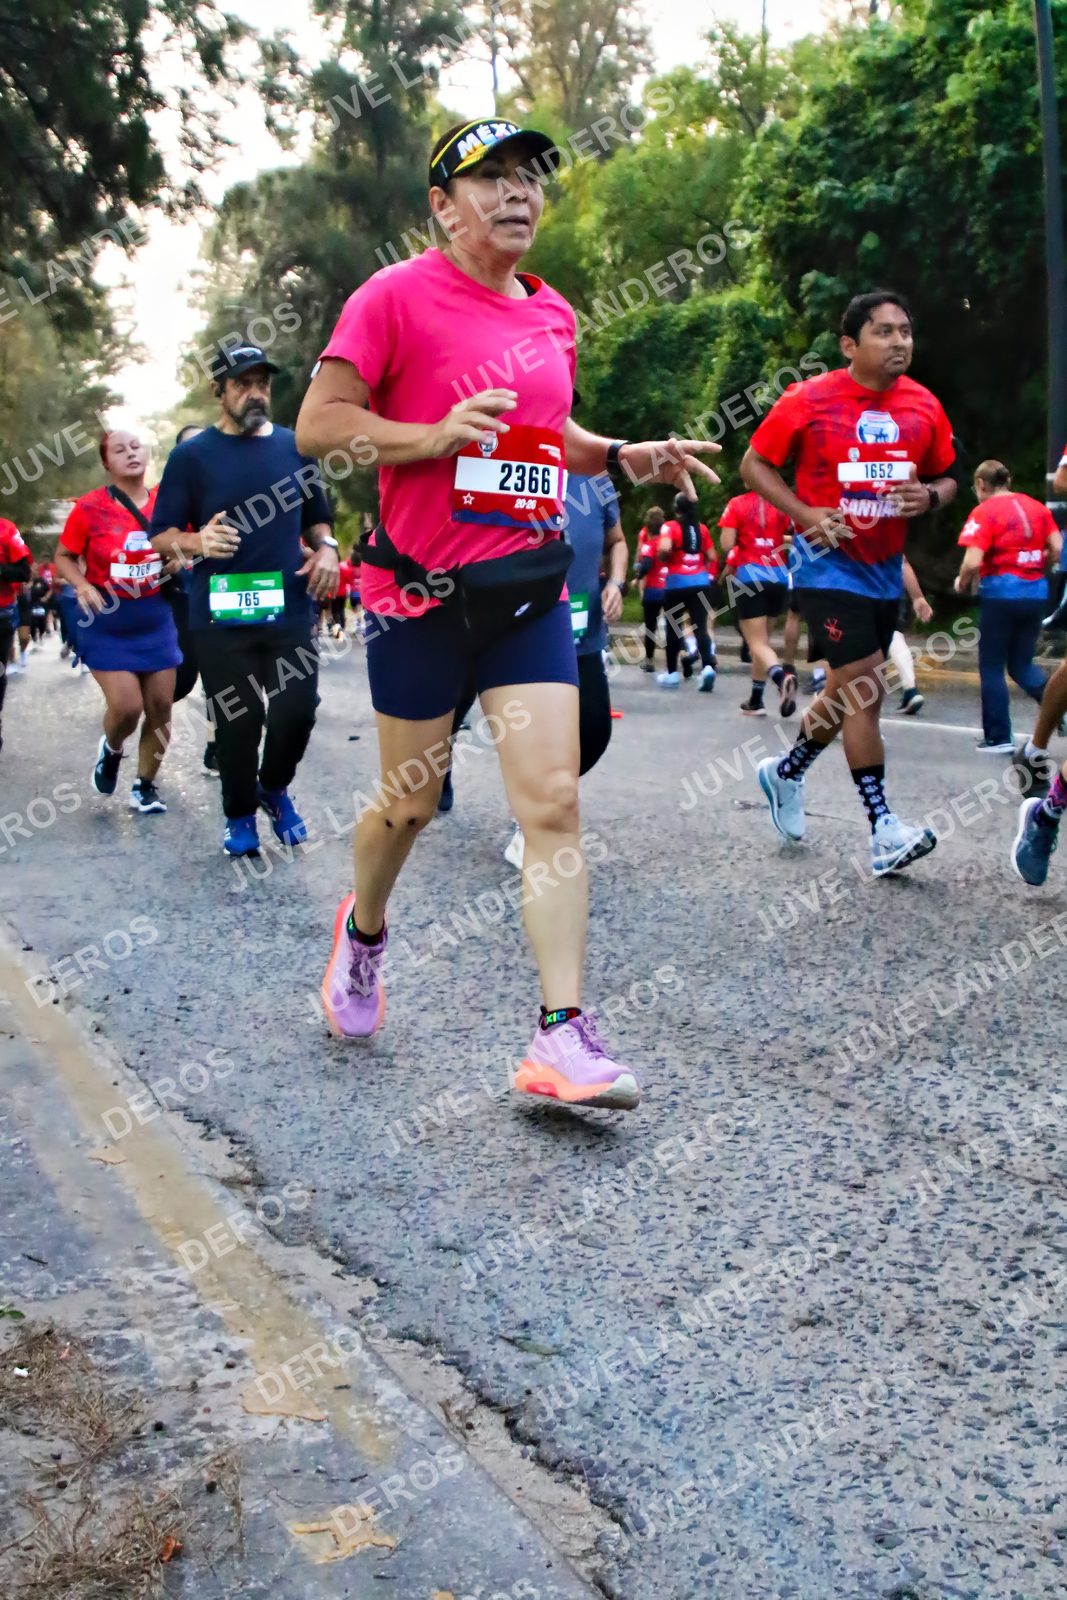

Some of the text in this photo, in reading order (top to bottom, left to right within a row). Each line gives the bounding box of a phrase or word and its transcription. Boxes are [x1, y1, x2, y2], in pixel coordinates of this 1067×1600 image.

[499, 462, 551, 495] 2366
[864, 463, 894, 479] 1652
[236, 591, 260, 607] 765
